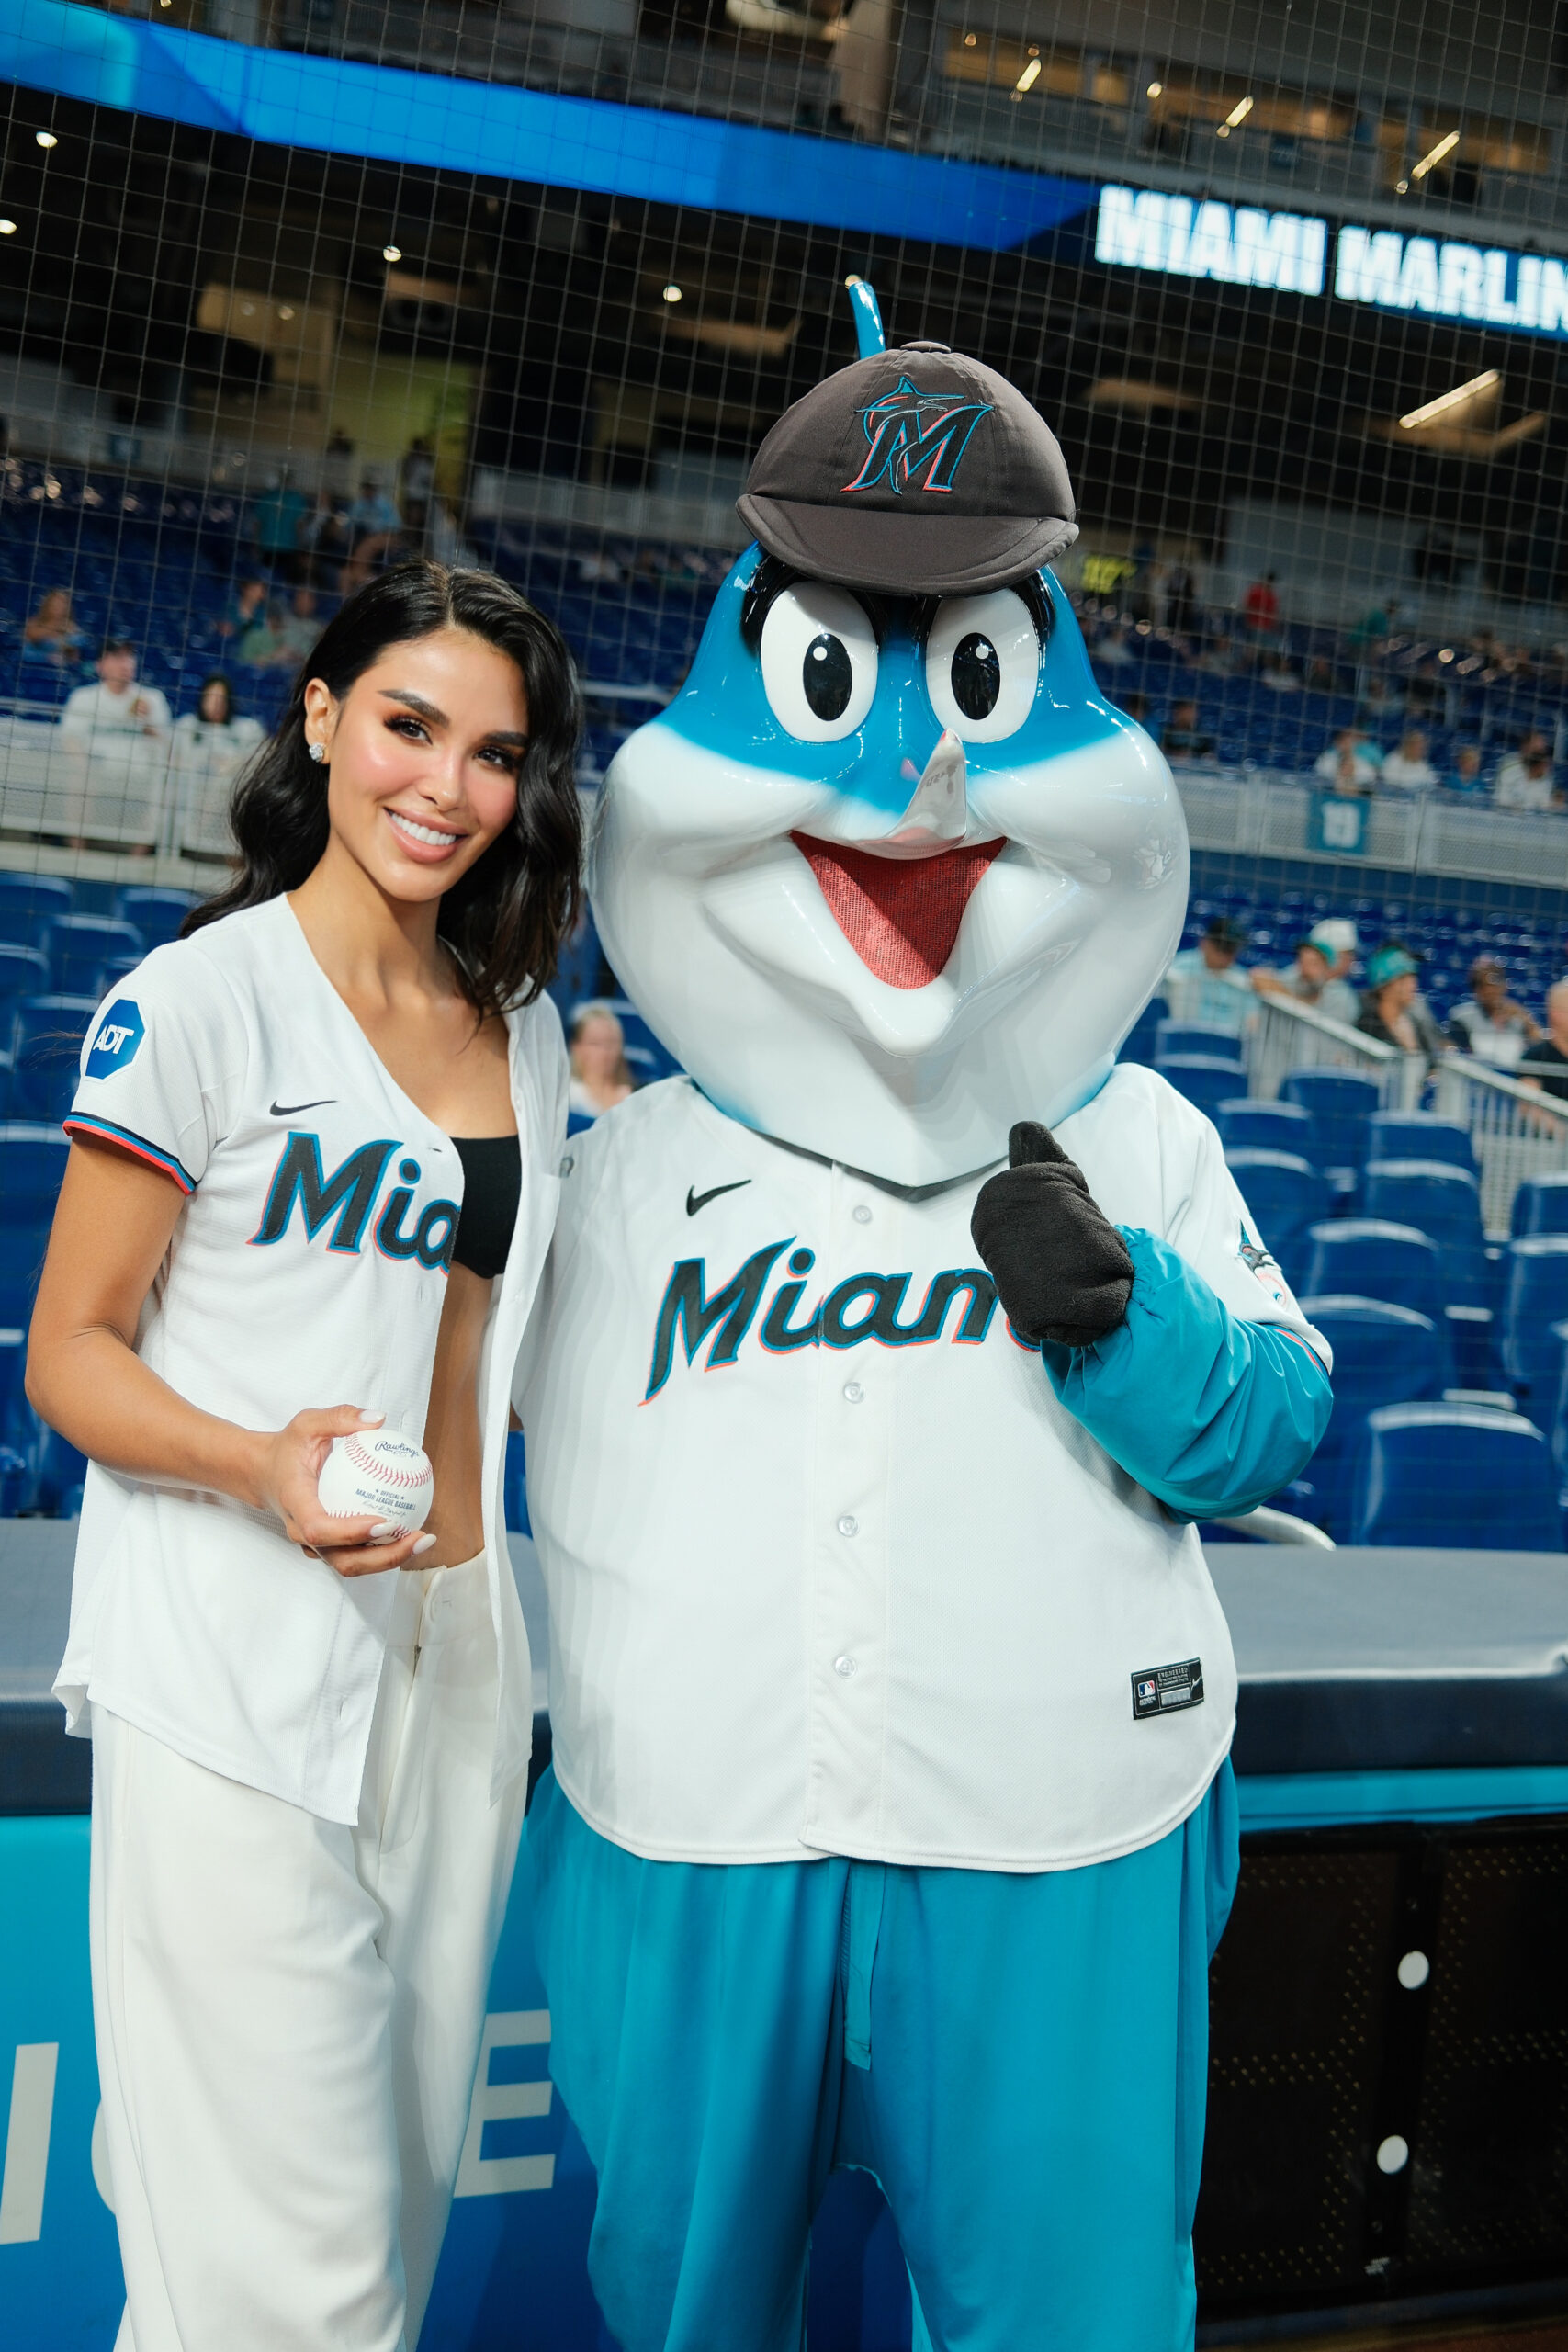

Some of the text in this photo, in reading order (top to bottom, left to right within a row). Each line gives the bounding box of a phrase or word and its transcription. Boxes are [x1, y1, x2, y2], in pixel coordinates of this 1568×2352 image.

[1095, 184, 1328, 297] MIAMI
[93, 1024, 135, 1055] ADT
[375, 1440, 419, 1458] Rawlings
[355, 1488, 376, 1501] MAJOR
[376, 1496, 394, 1507] LEAGUE
[394, 1500, 416, 1511] BASEBALL
[380, 1489, 400, 1500] OFFICIAL
